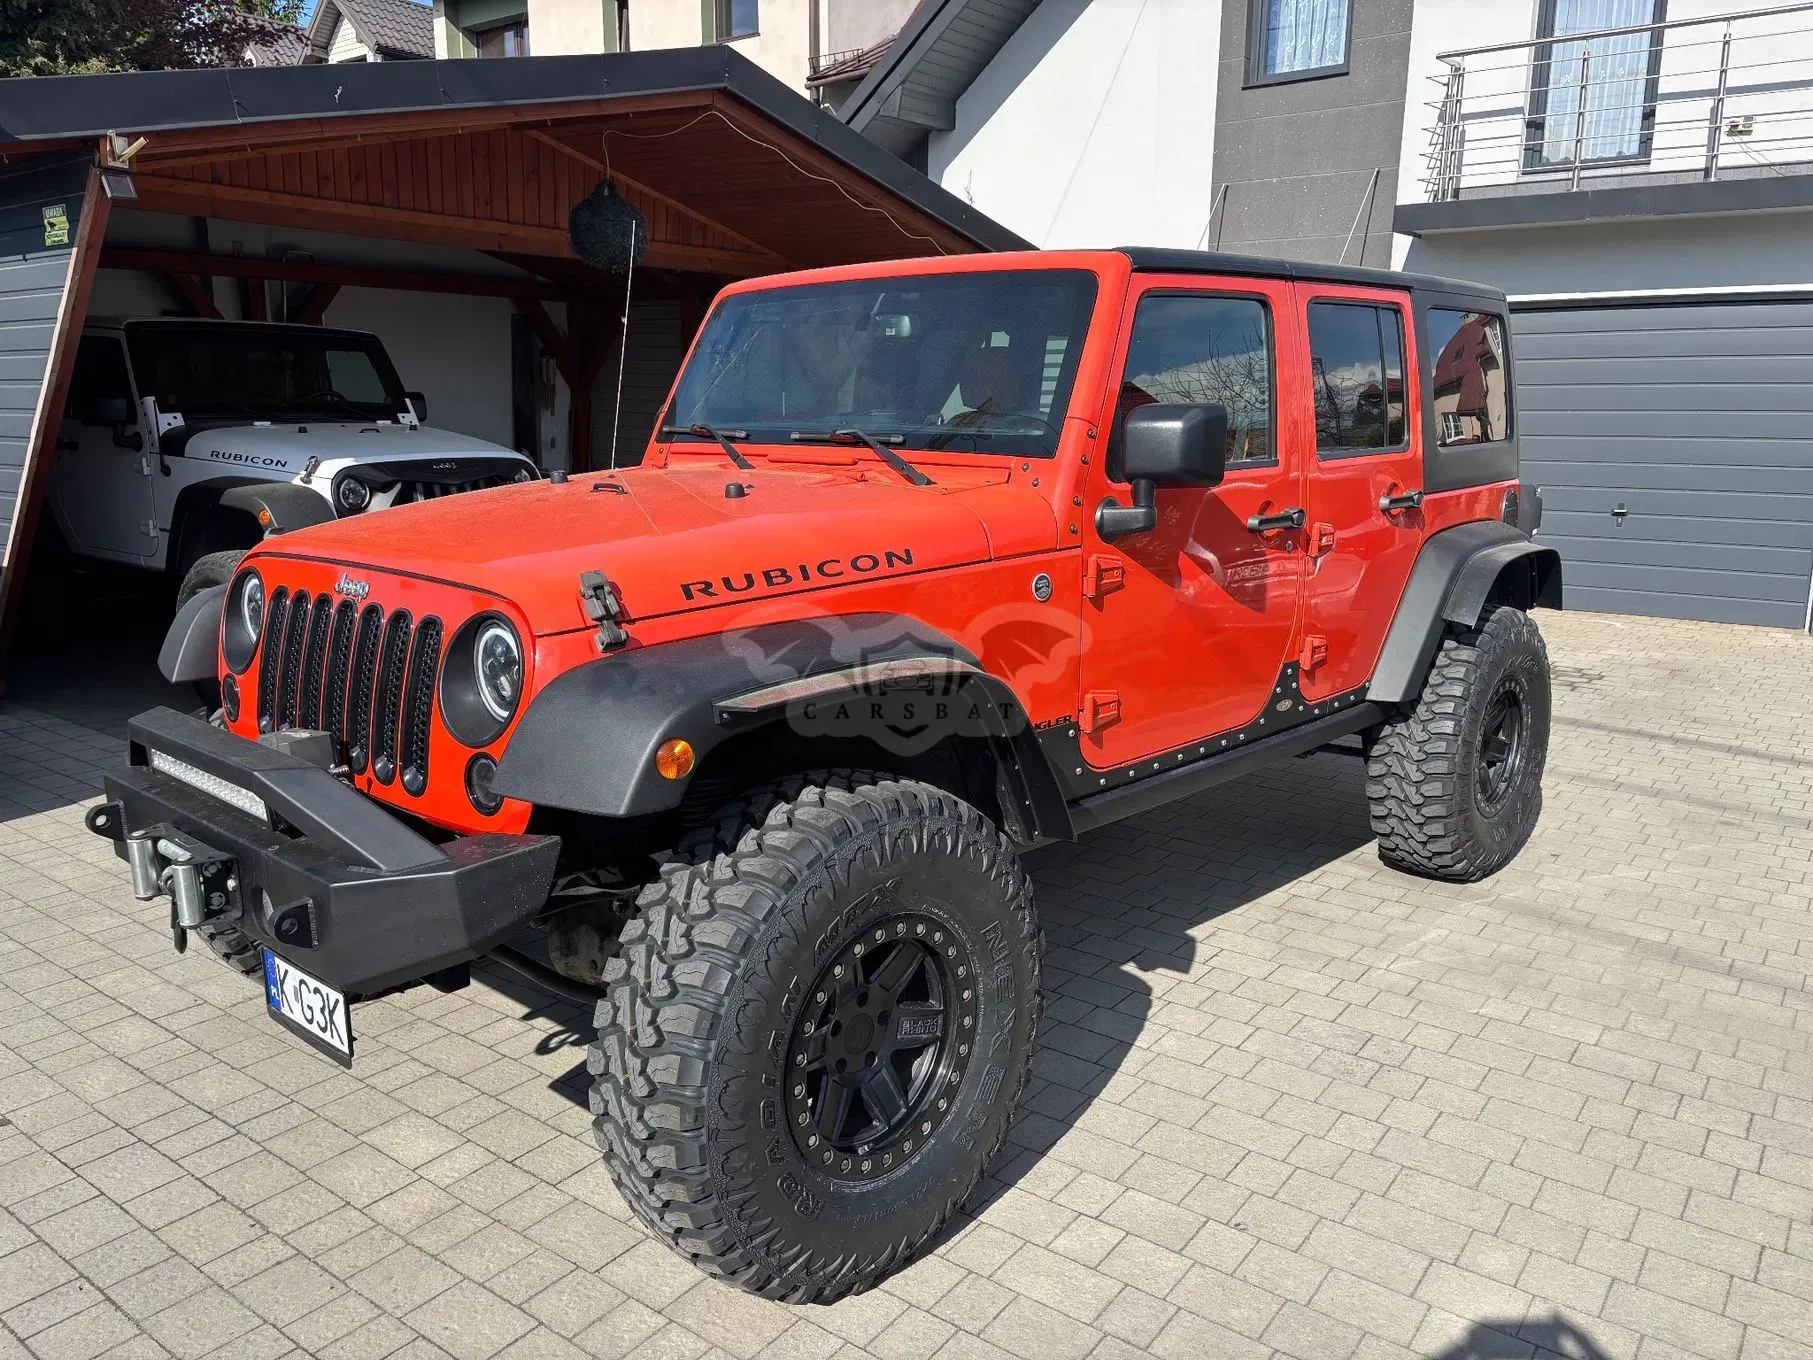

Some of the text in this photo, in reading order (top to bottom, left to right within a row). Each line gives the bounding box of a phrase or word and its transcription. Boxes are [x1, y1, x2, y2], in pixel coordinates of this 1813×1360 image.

[210, 450, 288, 468] RUBICON
[679, 548, 914, 601] RUBICON
[334, 572, 370, 603] Jeep
[901, 1024, 937, 1035] RHINO
[902, 1017, 938, 1028] BLACK
[950, 919, 1018, 1150] NEXEN
